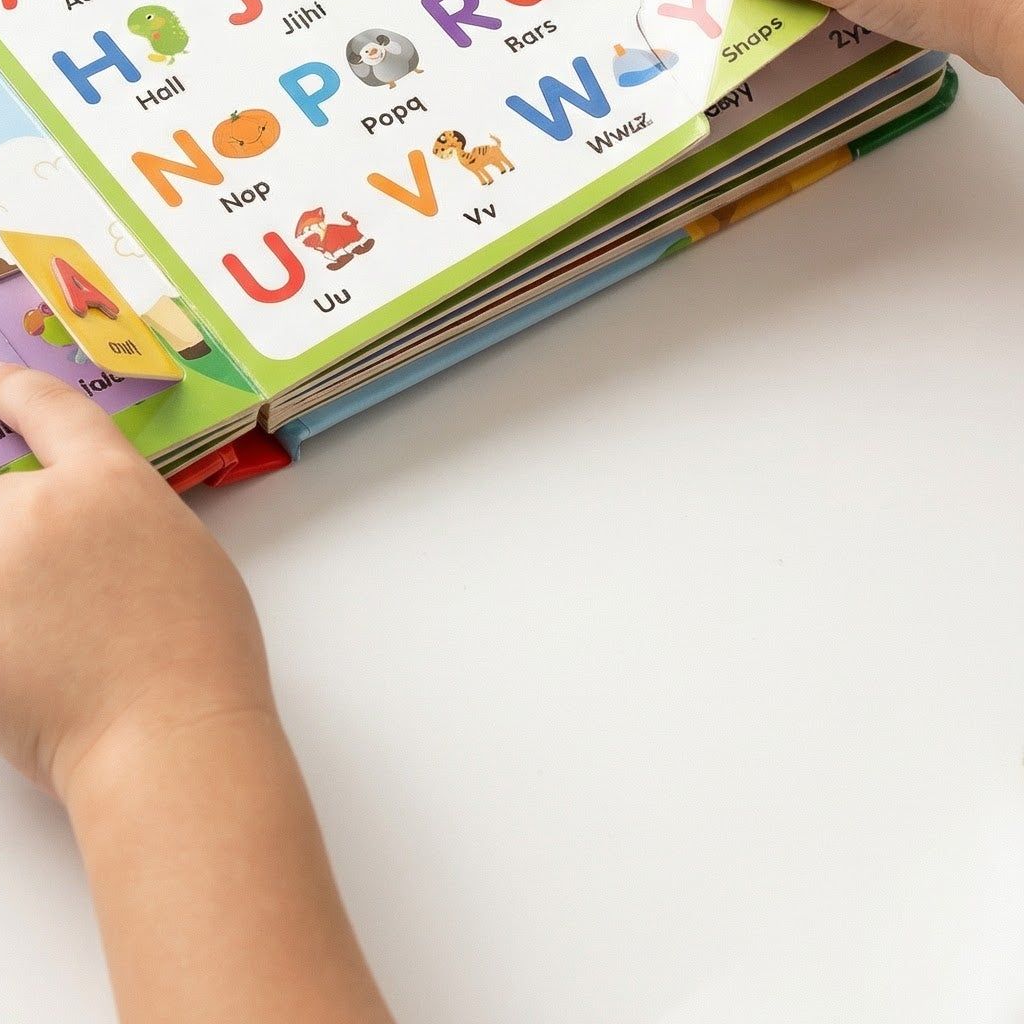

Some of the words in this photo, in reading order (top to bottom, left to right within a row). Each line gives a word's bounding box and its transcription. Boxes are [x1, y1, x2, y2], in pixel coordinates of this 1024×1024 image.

[722, 16, 784, 64] Shaps
[52, 31, 141, 104] H
[136, 77, 186, 110] Hall
[131, 130, 224, 207] N
[279, 62, 340, 127] P
[220, 180, 271, 213] Nop
[222, 232, 306, 305] U
[367, 150, 438, 217] V
[505, 57, 611, 141] W
[463, 203, 497, 226] Vv
[51, 257, 119, 320] A
[314, 288, 352, 314] Uu
